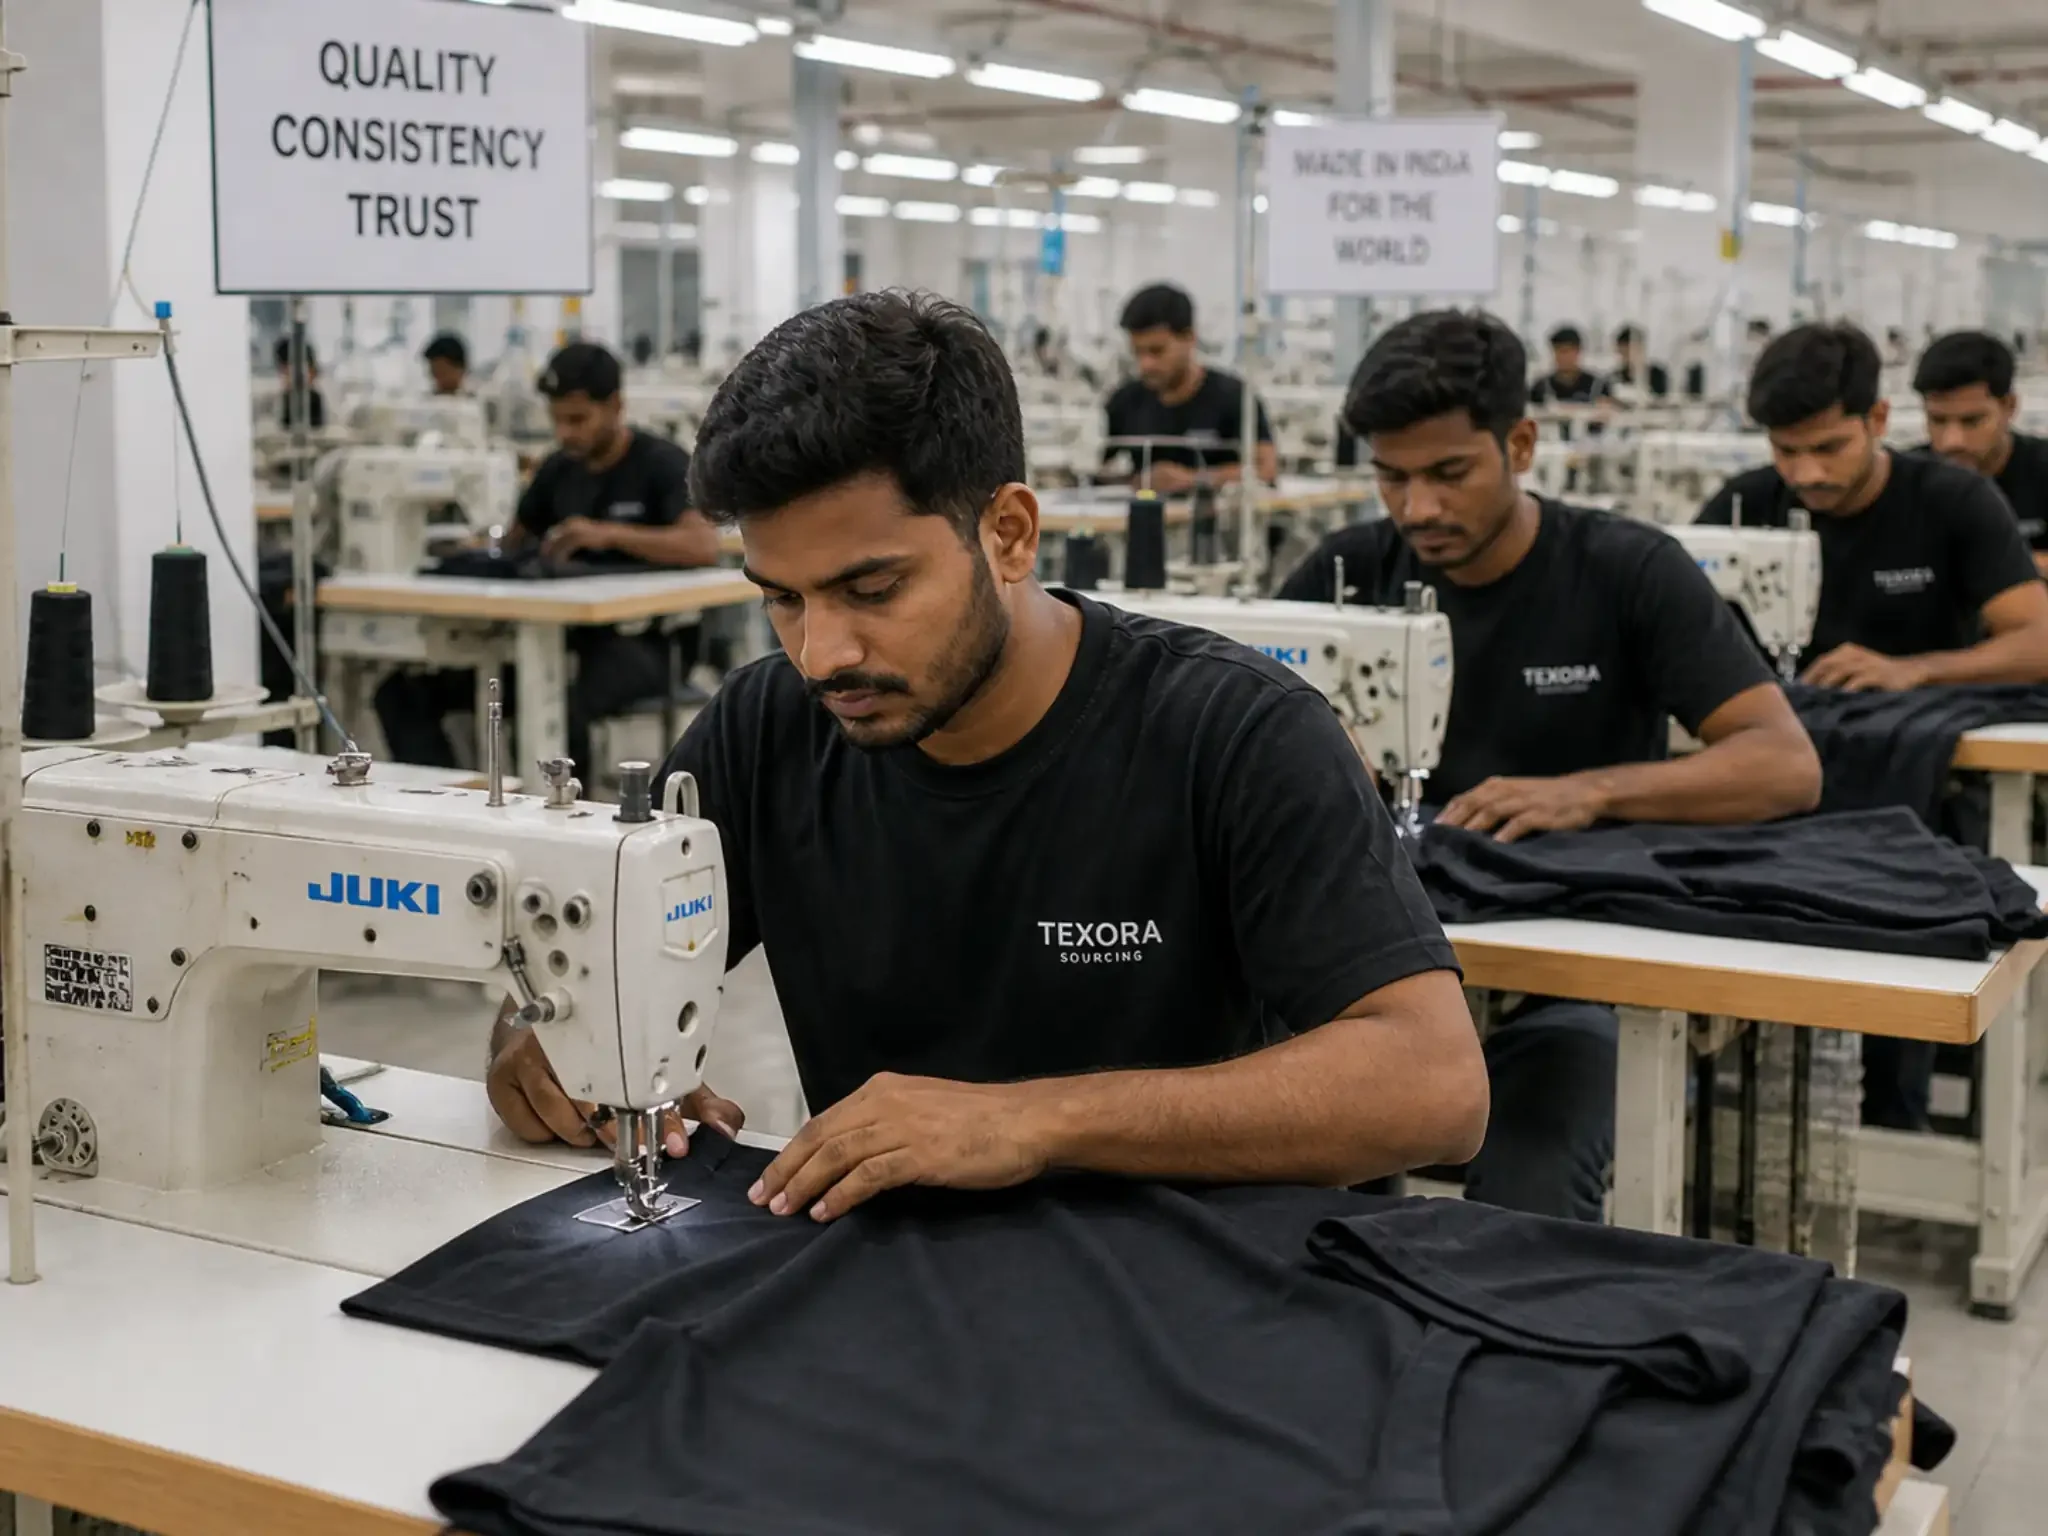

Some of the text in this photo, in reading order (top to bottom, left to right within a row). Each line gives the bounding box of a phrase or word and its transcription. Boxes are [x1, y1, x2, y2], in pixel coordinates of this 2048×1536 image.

[319, 40, 496, 95] QUALITY
[272, 113, 544, 170] CONSISTENCY
[346, 192, 480, 239] TRUST
[1333, 234, 1432, 266] WORLD
[308, 872, 439, 915] JUKI
[666, 894, 712, 922] JUKI
[1037, 919, 1163, 947] TEXORA
[1060, 950, 1143, 963] SOURCING
